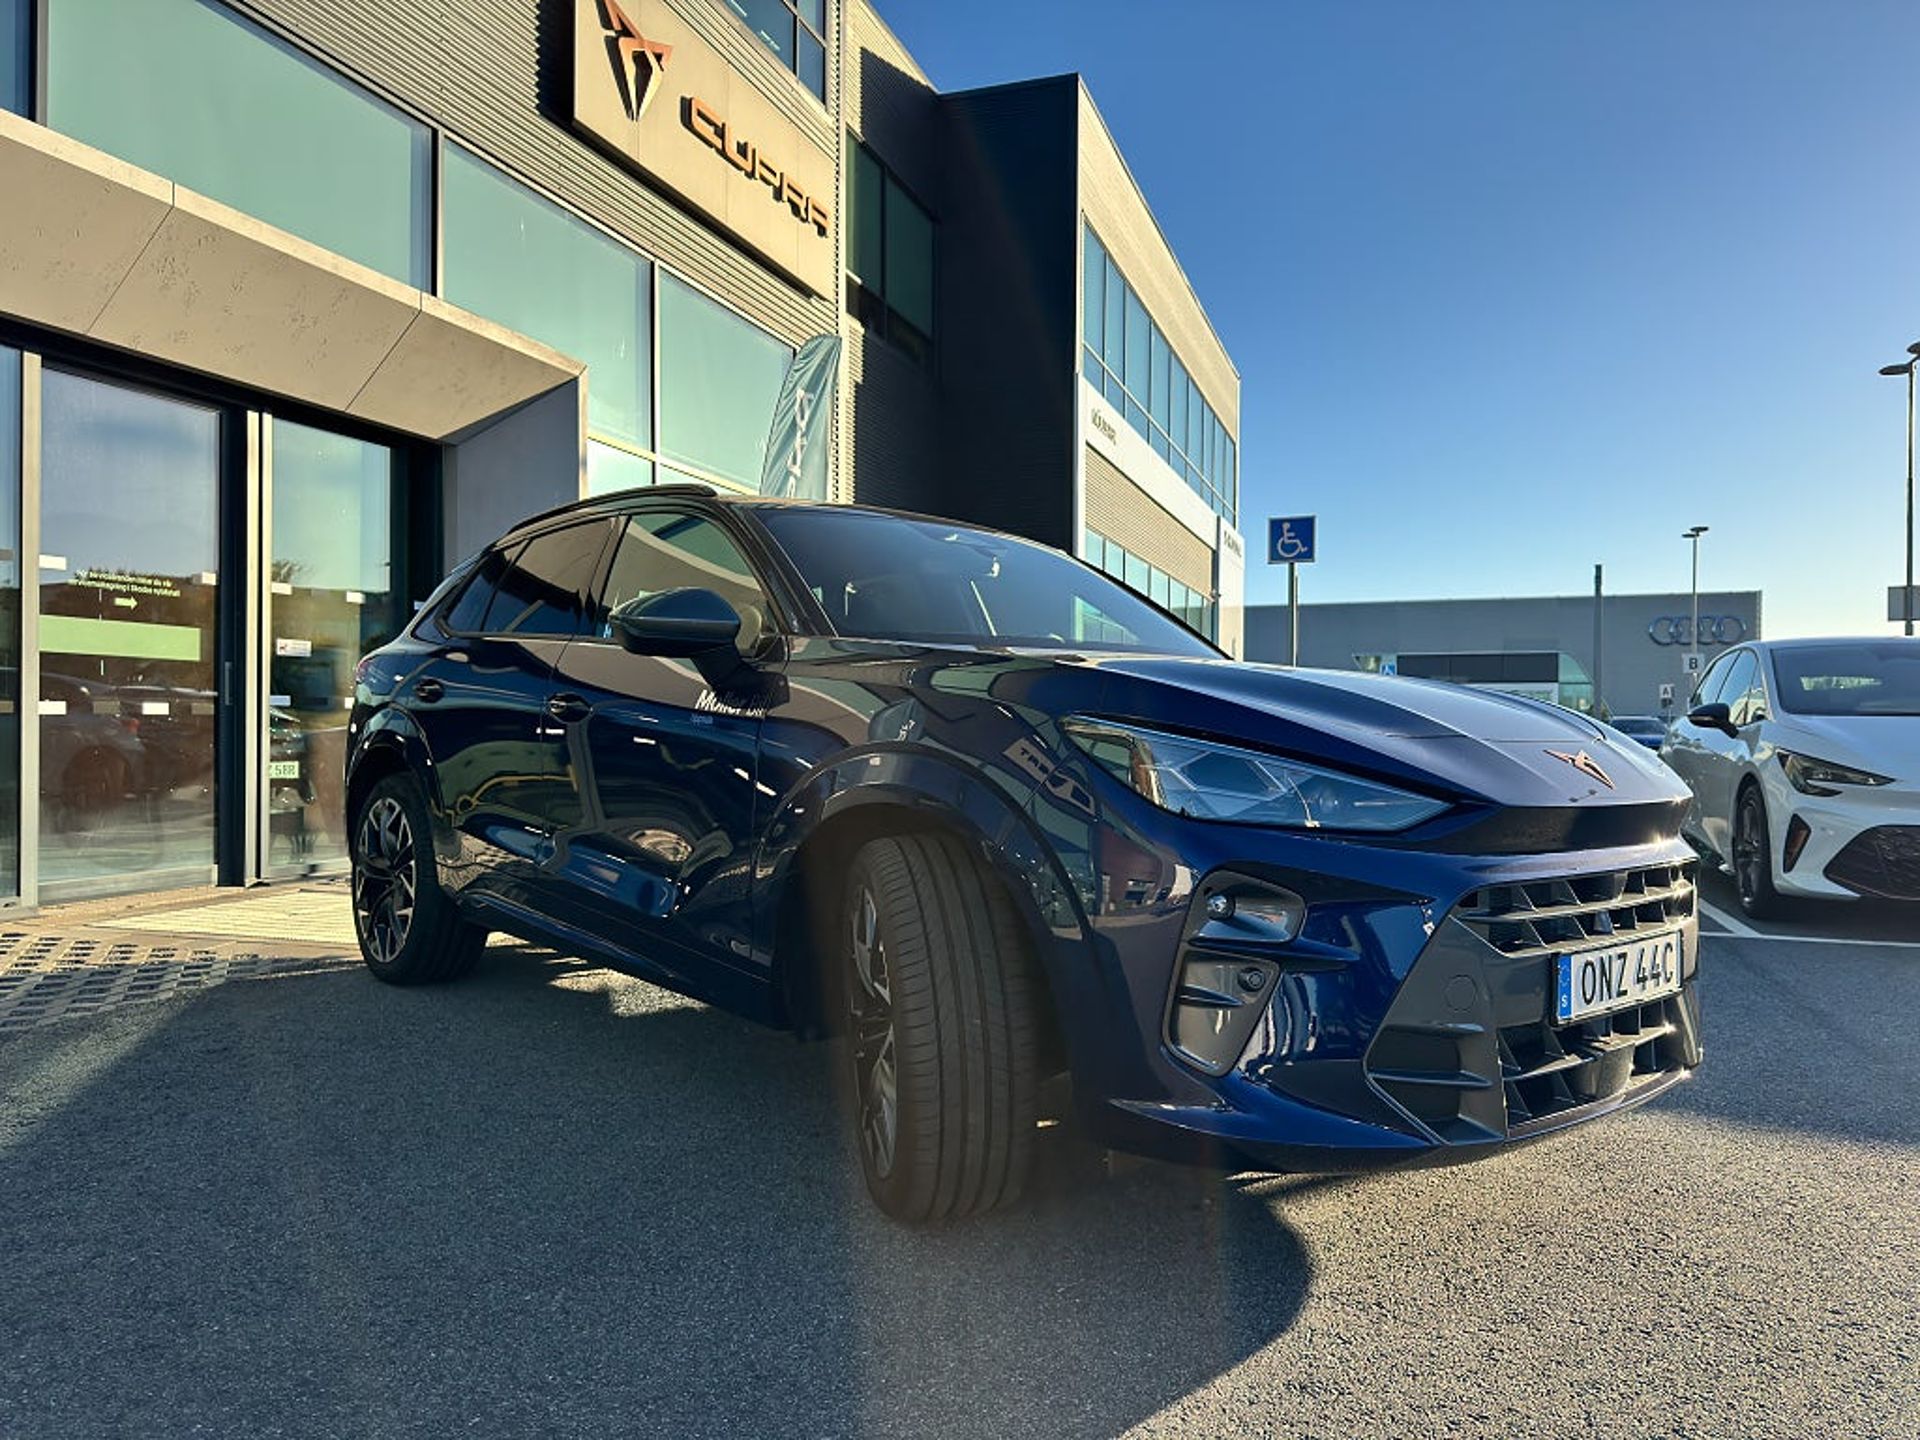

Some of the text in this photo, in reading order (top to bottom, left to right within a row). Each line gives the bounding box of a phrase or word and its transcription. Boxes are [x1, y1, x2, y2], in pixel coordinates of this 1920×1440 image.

[684, 96, 831, 236] CUPRA
[1688, 657, 1698, 670] B
[1662, 687, 1671, 697] A
[1582, 941, 1674, 1006] ONZ 44C
[1561, 994, 1568, 1008] S
